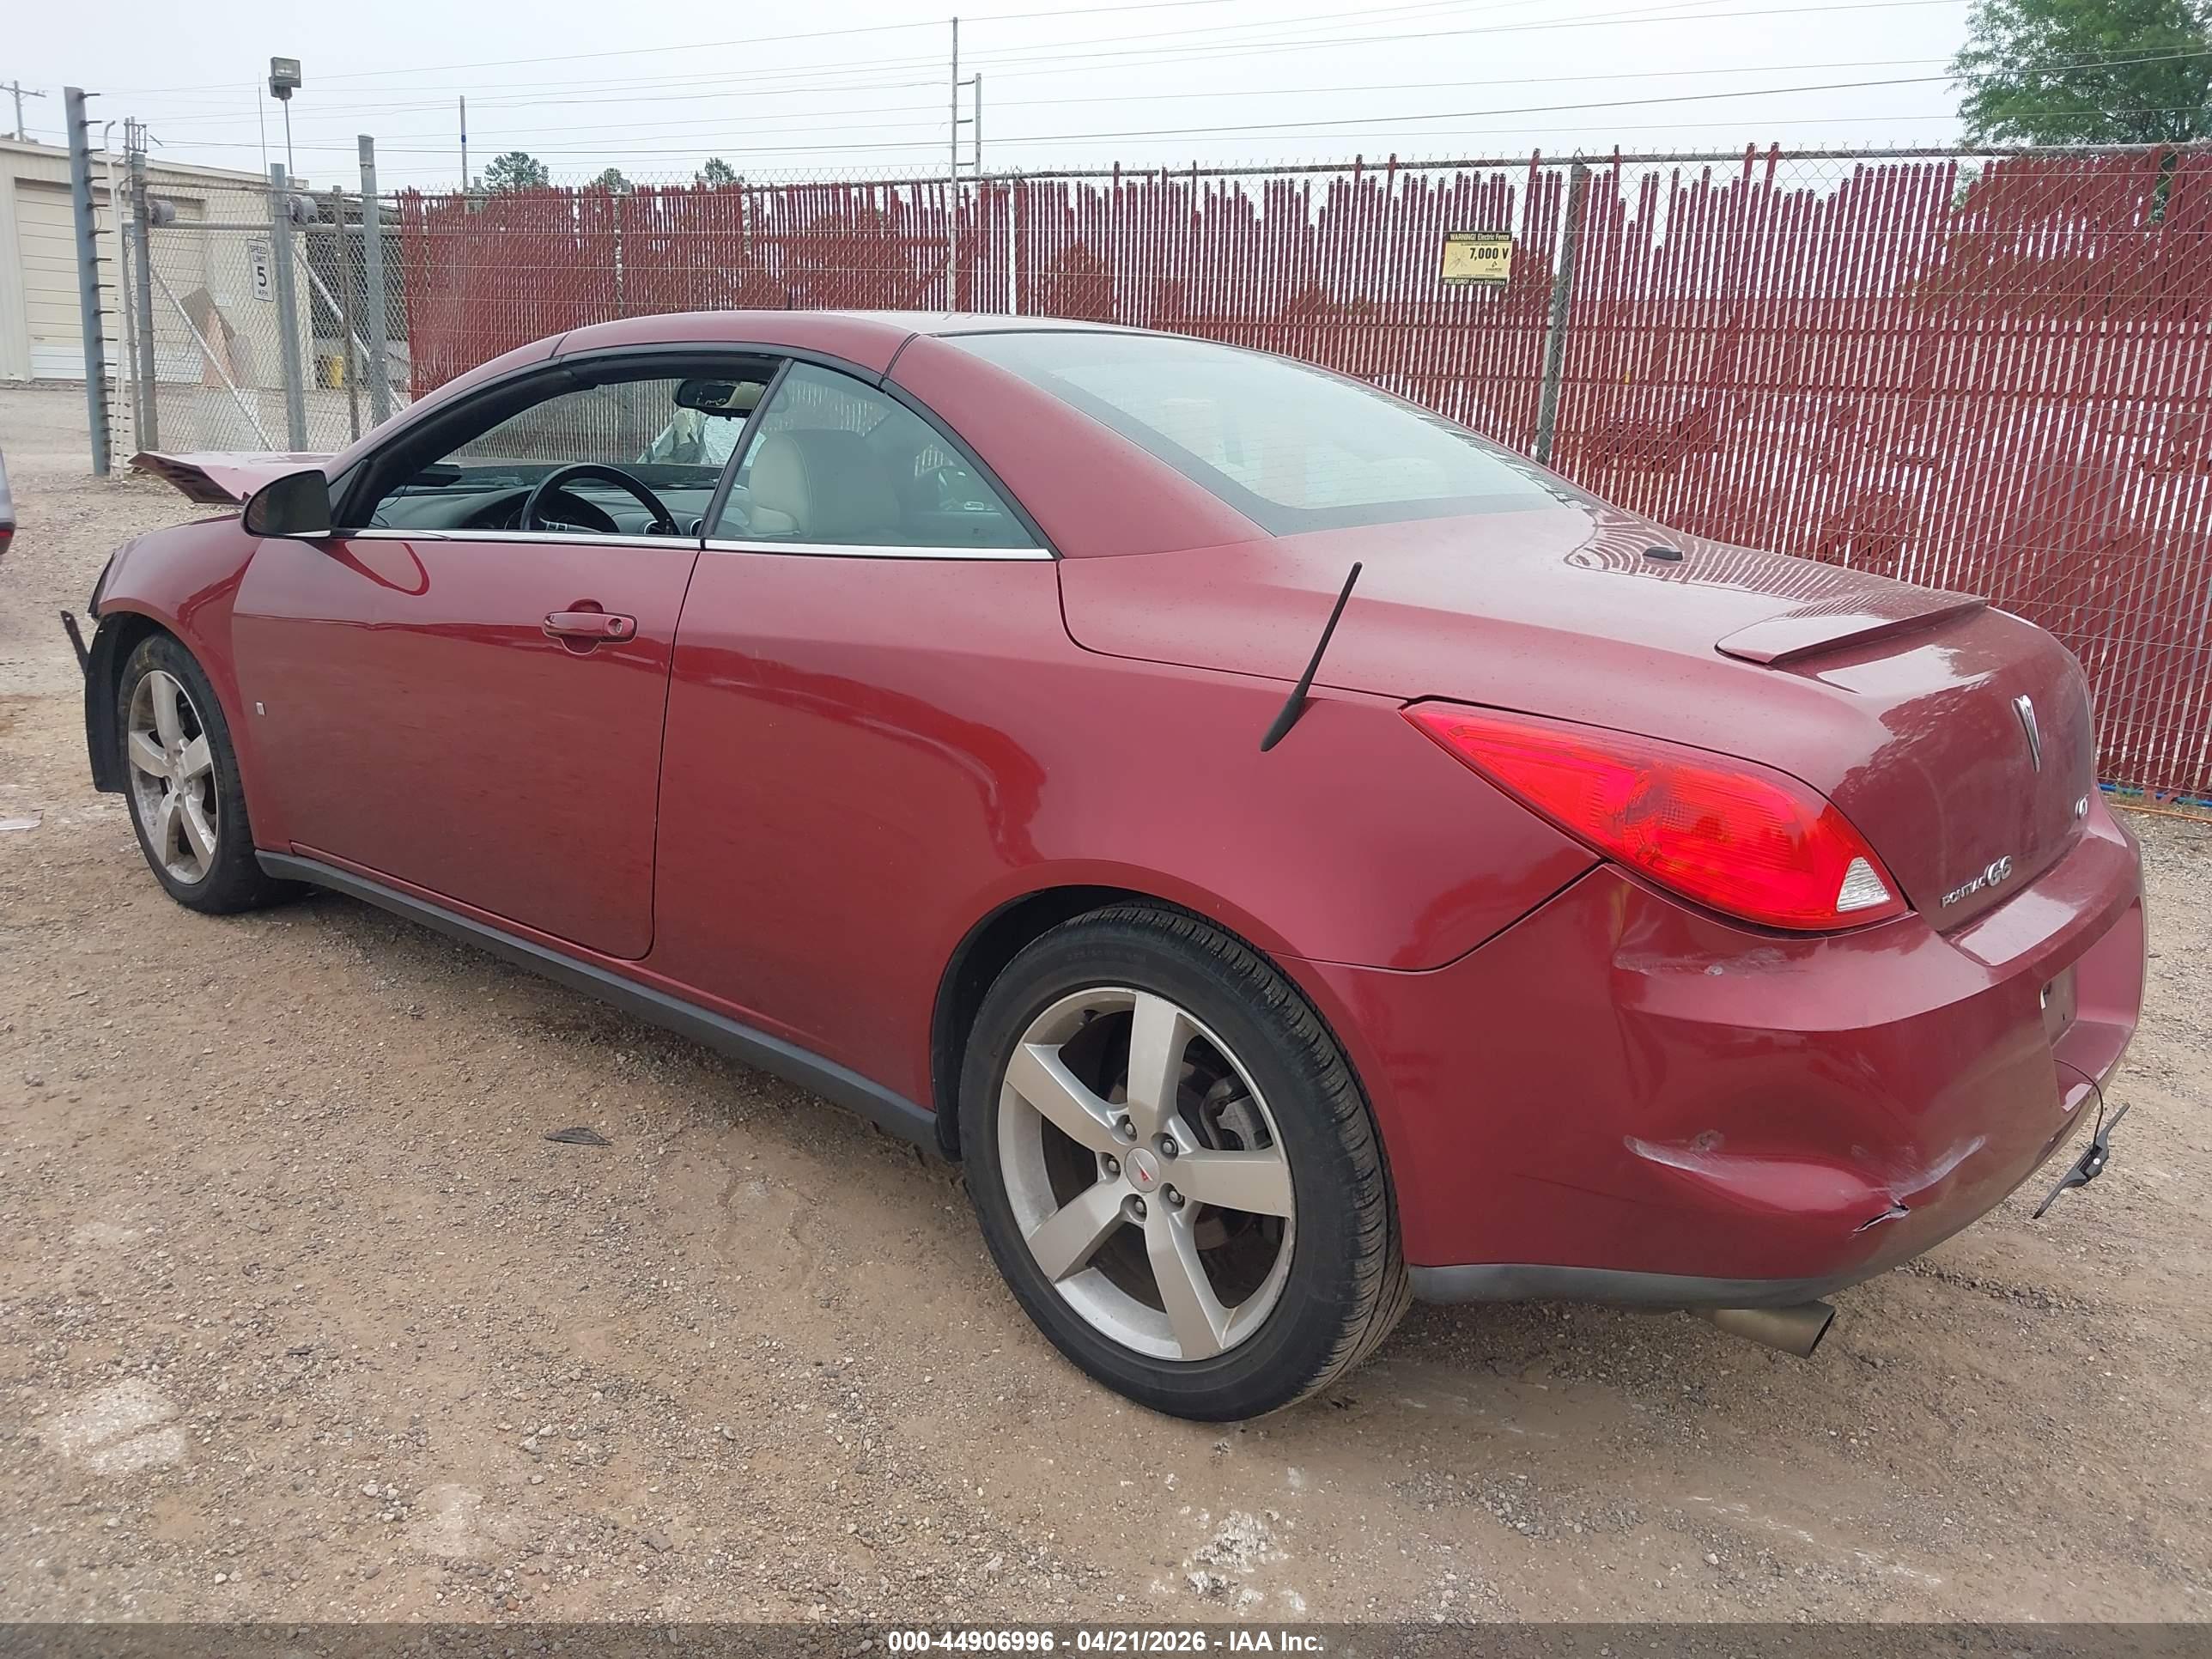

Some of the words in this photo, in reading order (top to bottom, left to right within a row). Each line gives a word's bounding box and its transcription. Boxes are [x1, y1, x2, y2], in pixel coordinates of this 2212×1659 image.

[1449, 233, 1477, 241] WARNING!
[1477, 233, 1495, 241] Electric
[249, 245, 267, 255] SPEED
[1469, 247, 1499, 261] 7,000
[1502, 247, 1510, 259] V
[257, 265, 267, 288] 5
[1941, 876, 1986, 908] PONTIAC
[1984, 855, 2013, 887] G6
